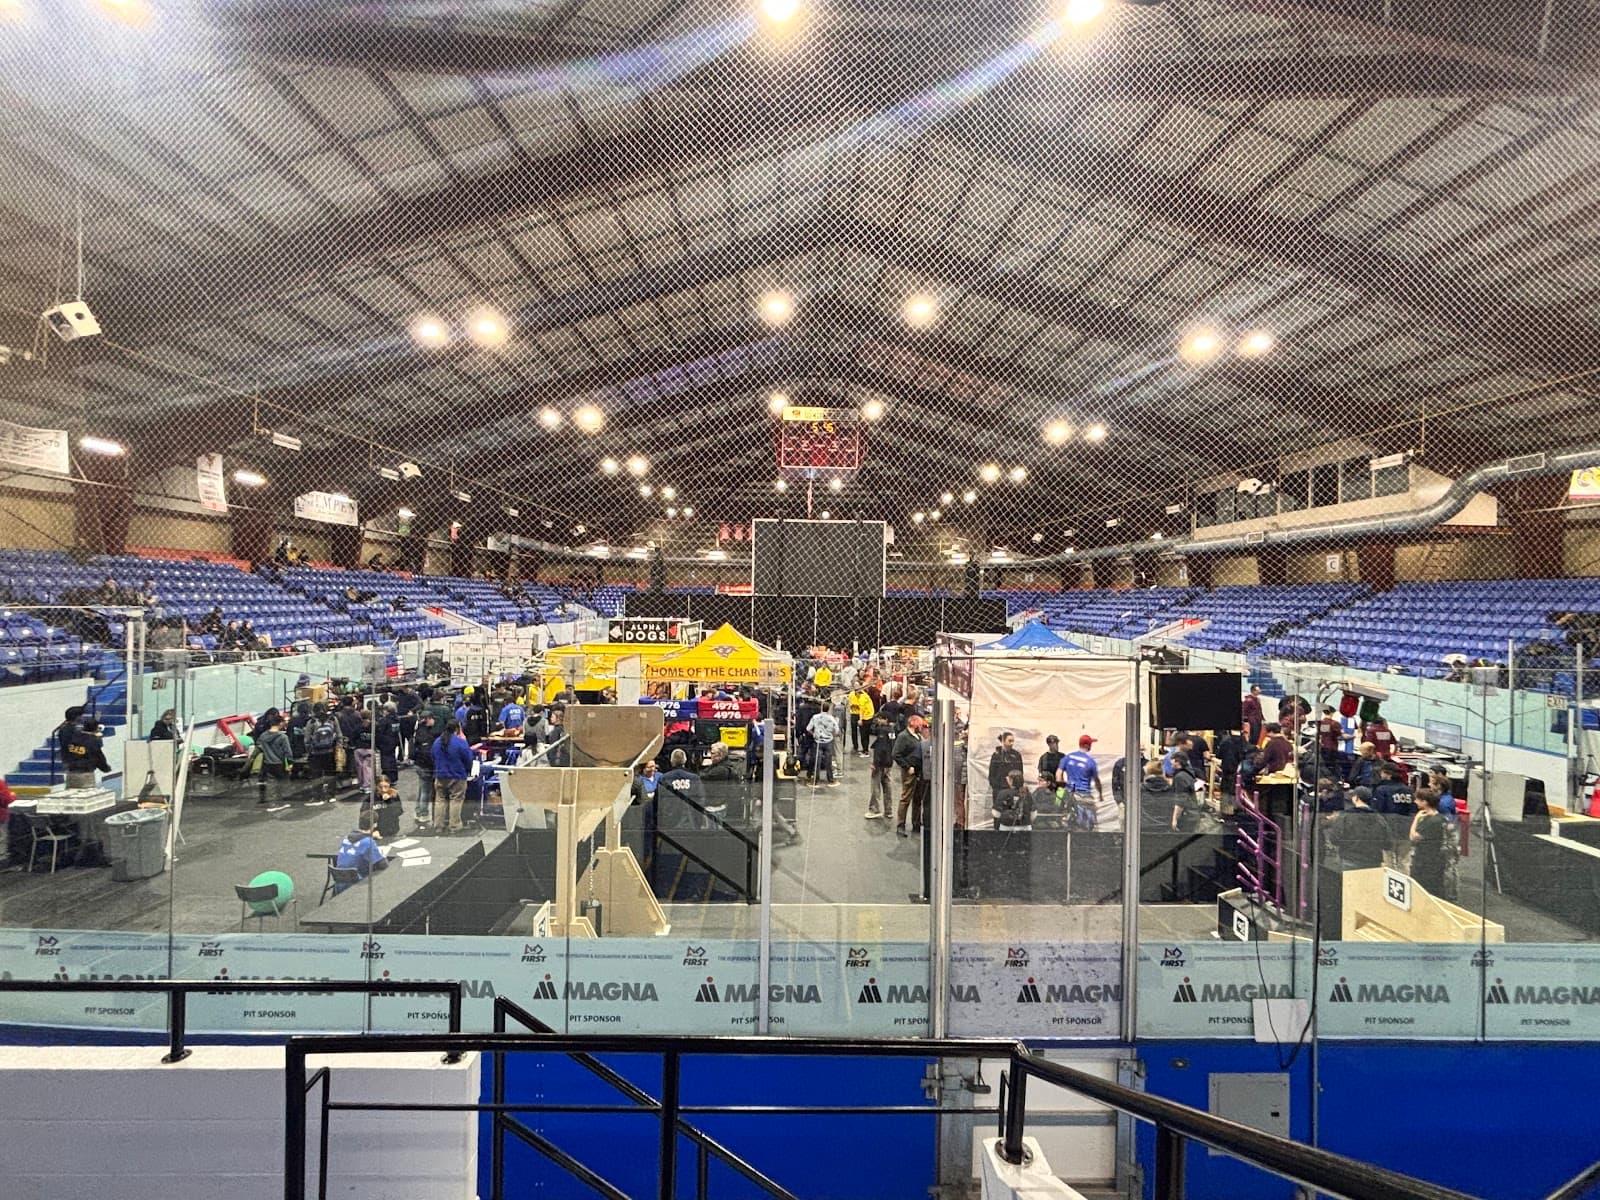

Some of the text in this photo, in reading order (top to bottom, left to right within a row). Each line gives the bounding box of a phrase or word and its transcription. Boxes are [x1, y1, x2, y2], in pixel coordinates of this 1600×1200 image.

[625, 631, 666, 641] DOGS
[651, 667, 684, 677] HOME
[687, 667, 701, 677] OF
[704, 667, 725, 677] THE
[712, 702, 740, 711] 4976
[714, 711, 742, 720] 4976
[198, 949, 225, 957] FIRST
[520, 955, 547, 963] FIRST
[682, 958, 709, 966] FIRST
[845, 959, 871, 968] FIRST
[1004, 959, 1030, 968] FIRST
[1160, 959, 1186, 968] FIRST
[563, 981, 659, 1002] MAGNA
[886, 984, 981, 1003] MANA
[1045, 984, 1122, 1003] MAGN
[1201, 983, 1293, 1002] MAGNA
[1357, 983, 1450, 1003] MAGNA
[243, 1010, 296, 1018] PIT SPONSOR
[569, 1014, 622, 1023] PIT SPONSOR
[731, 1016, 743, 1024] PIT
[894, 1017, 929, 1025] PIT SPON
[1052, 1016, 1102, 1025] PIT SPONSOR
[1208, 1016, 1254, 1024] PIT SPONSO
[1364, 1016, 1415, 1024] PIT SPONSOR
